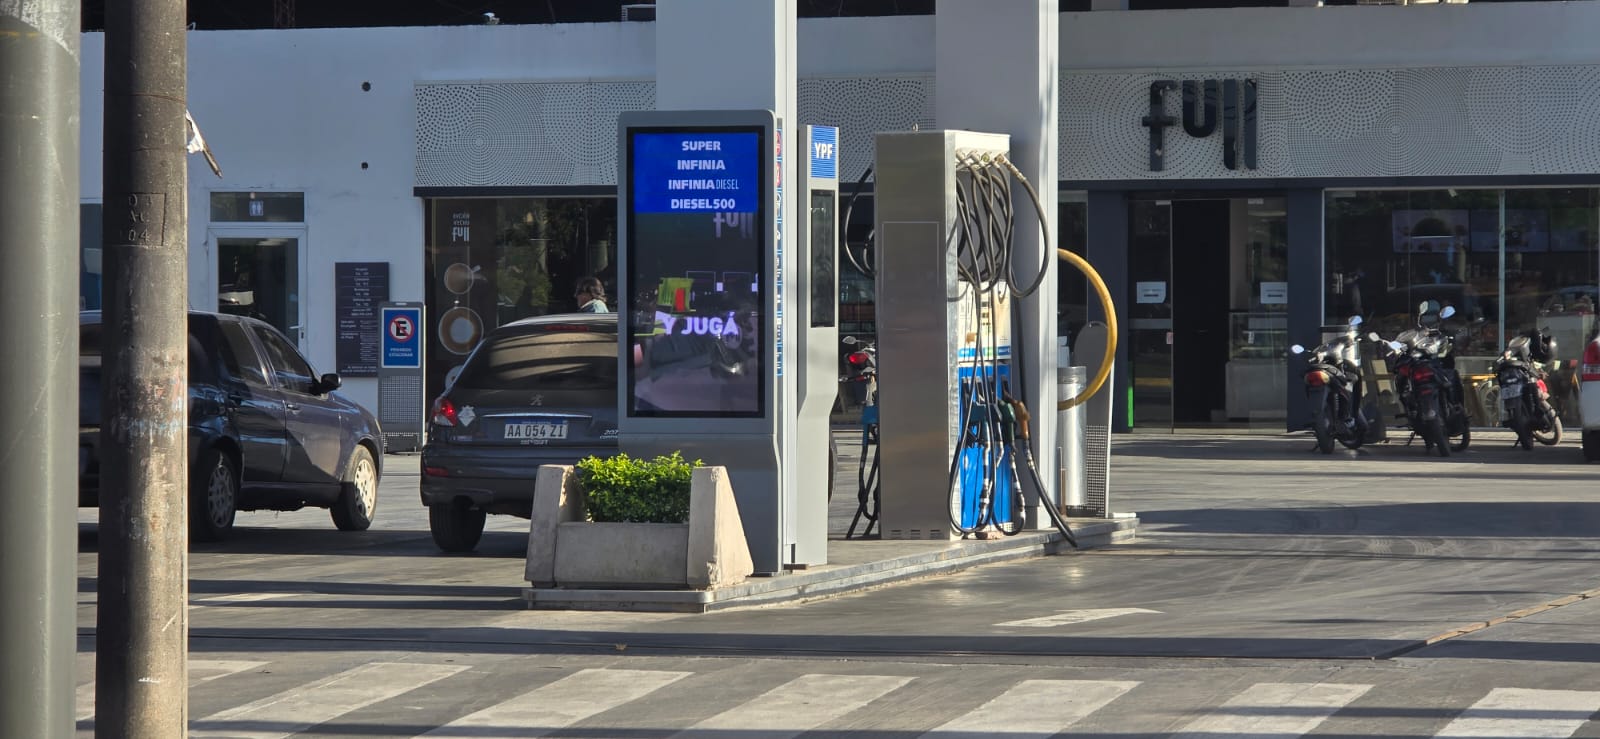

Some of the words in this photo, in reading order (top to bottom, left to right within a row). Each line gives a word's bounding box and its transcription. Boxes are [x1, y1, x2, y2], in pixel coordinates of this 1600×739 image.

[1142, 79, 1257, 171] full
[681, 141, 721, 151] SUPER
[814, 143, 833, 159] YPF
[677, 160, 725, 170] INFINIA
[668, 180, 714, 190] INFINIA
[715, 179, 739, 190] DIESEL
[452, 226, 470, 242] full
[681, 312, 739, 335] JUGÁ
[507, 425, 521, 438] AA
[525, 425, 546, 438] 054
